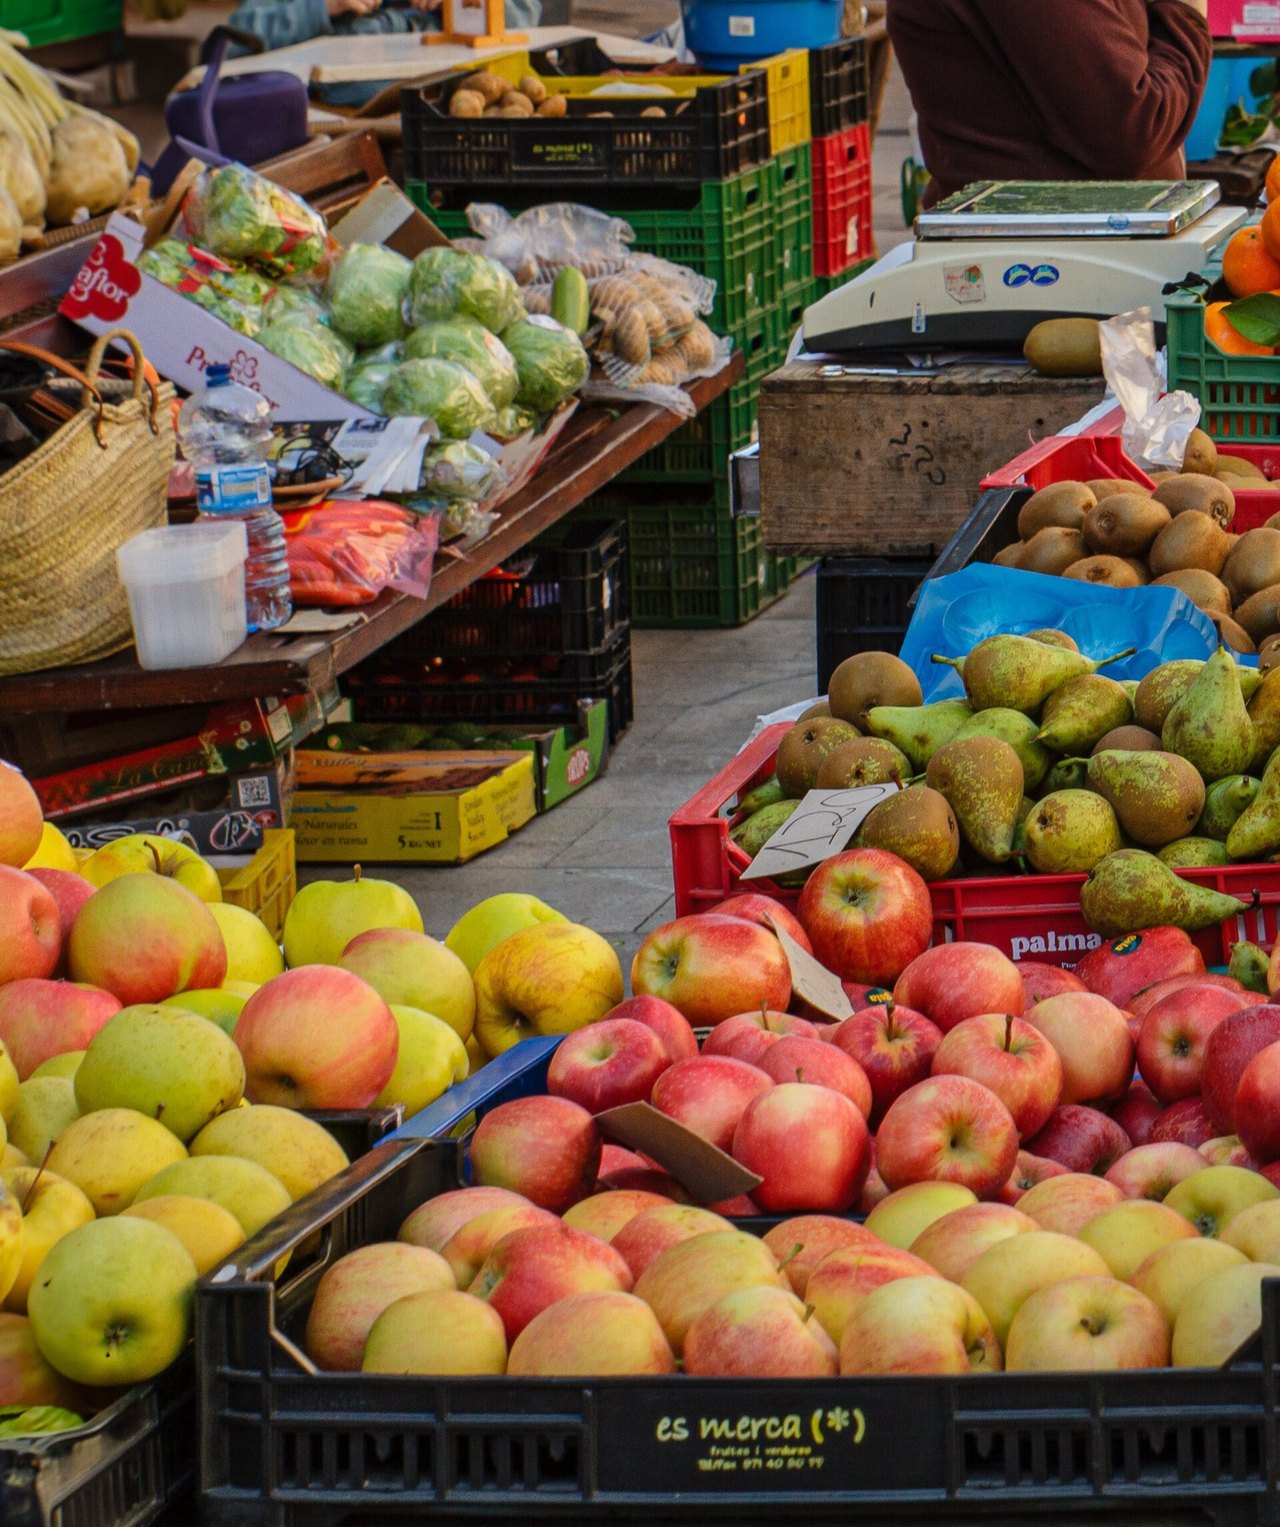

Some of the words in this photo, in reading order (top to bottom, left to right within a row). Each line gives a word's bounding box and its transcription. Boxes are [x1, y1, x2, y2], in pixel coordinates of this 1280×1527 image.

[397, 834, 407, 849] 5
[1010, 930, 1102, 961] palma
[656, 1415, 690, 1442] es
[699, 1413, 802, 1441] merca
